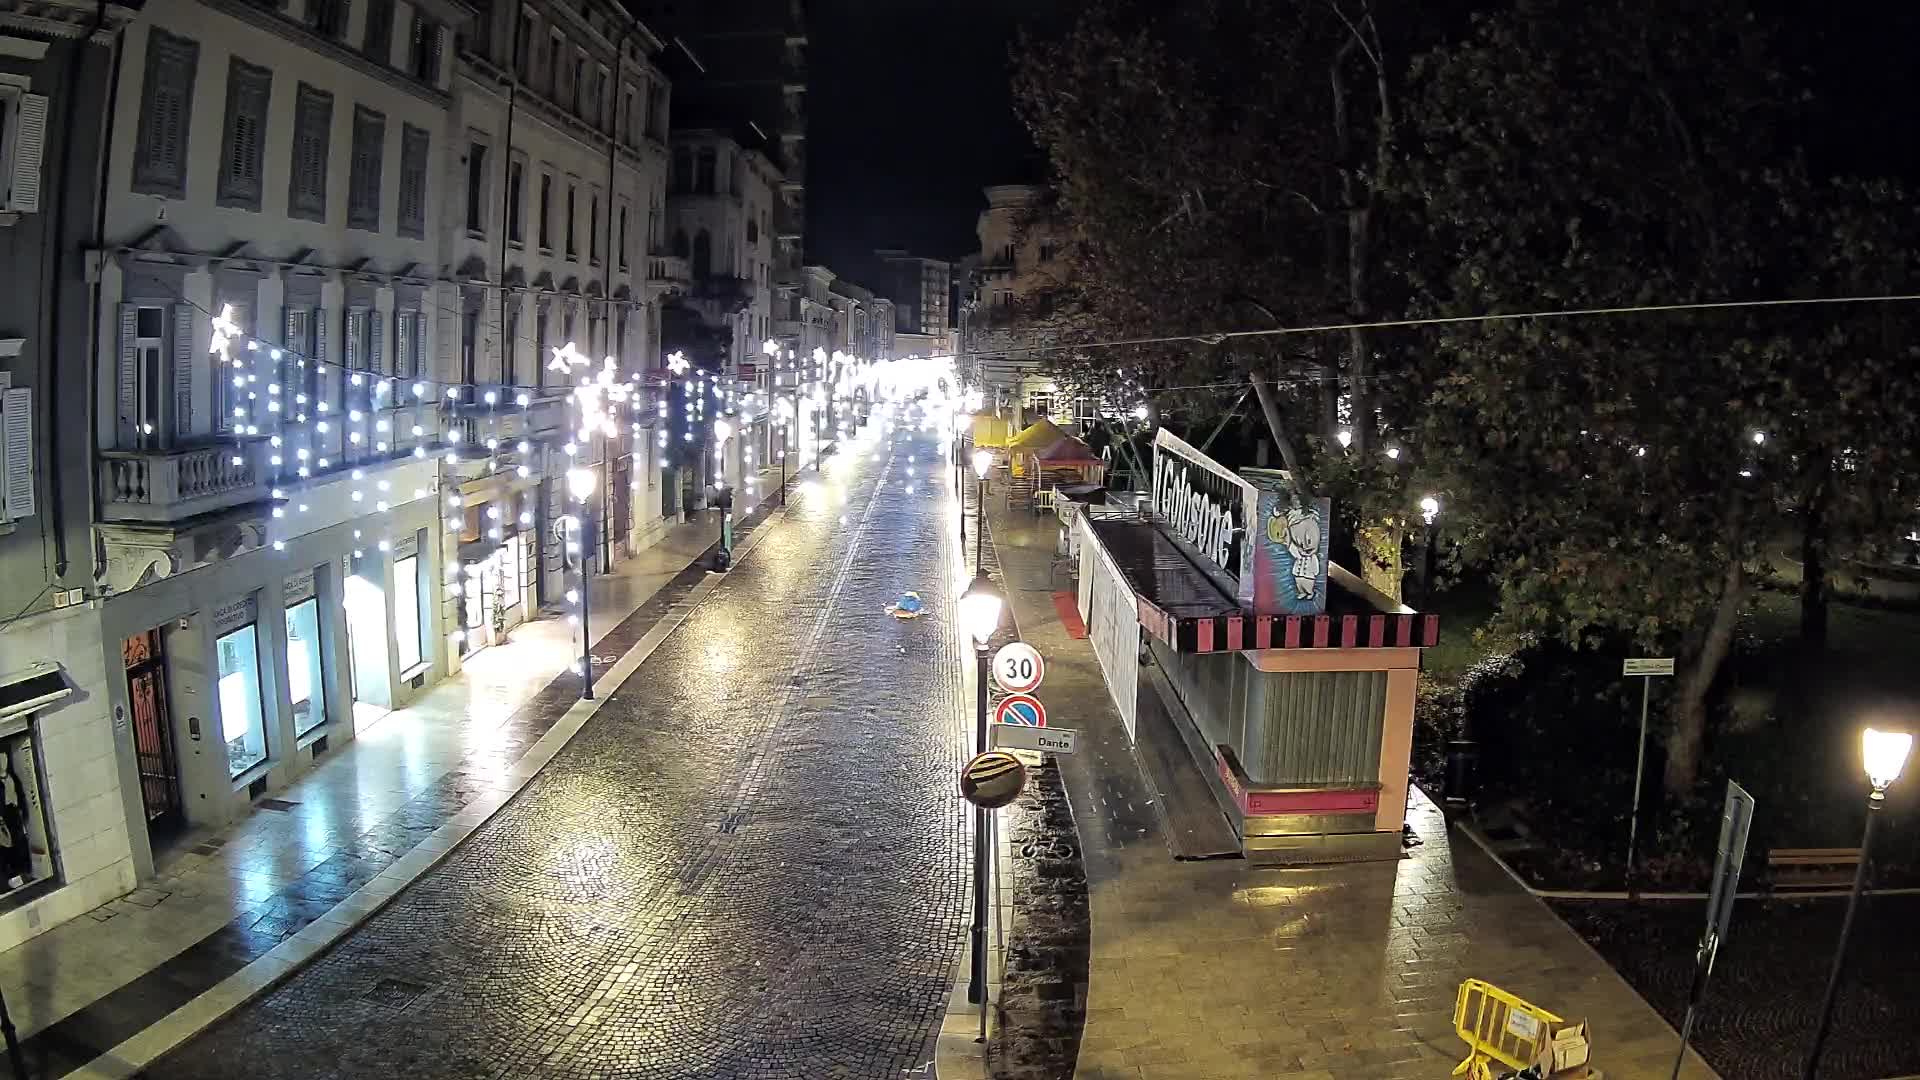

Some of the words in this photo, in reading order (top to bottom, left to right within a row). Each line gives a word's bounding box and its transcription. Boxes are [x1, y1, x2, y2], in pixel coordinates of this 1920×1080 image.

[1162, 459, 1232, 570] Golosone
[1006, 658, 1032, 680] 30
[1038, 737, 1070, 749] Dante
